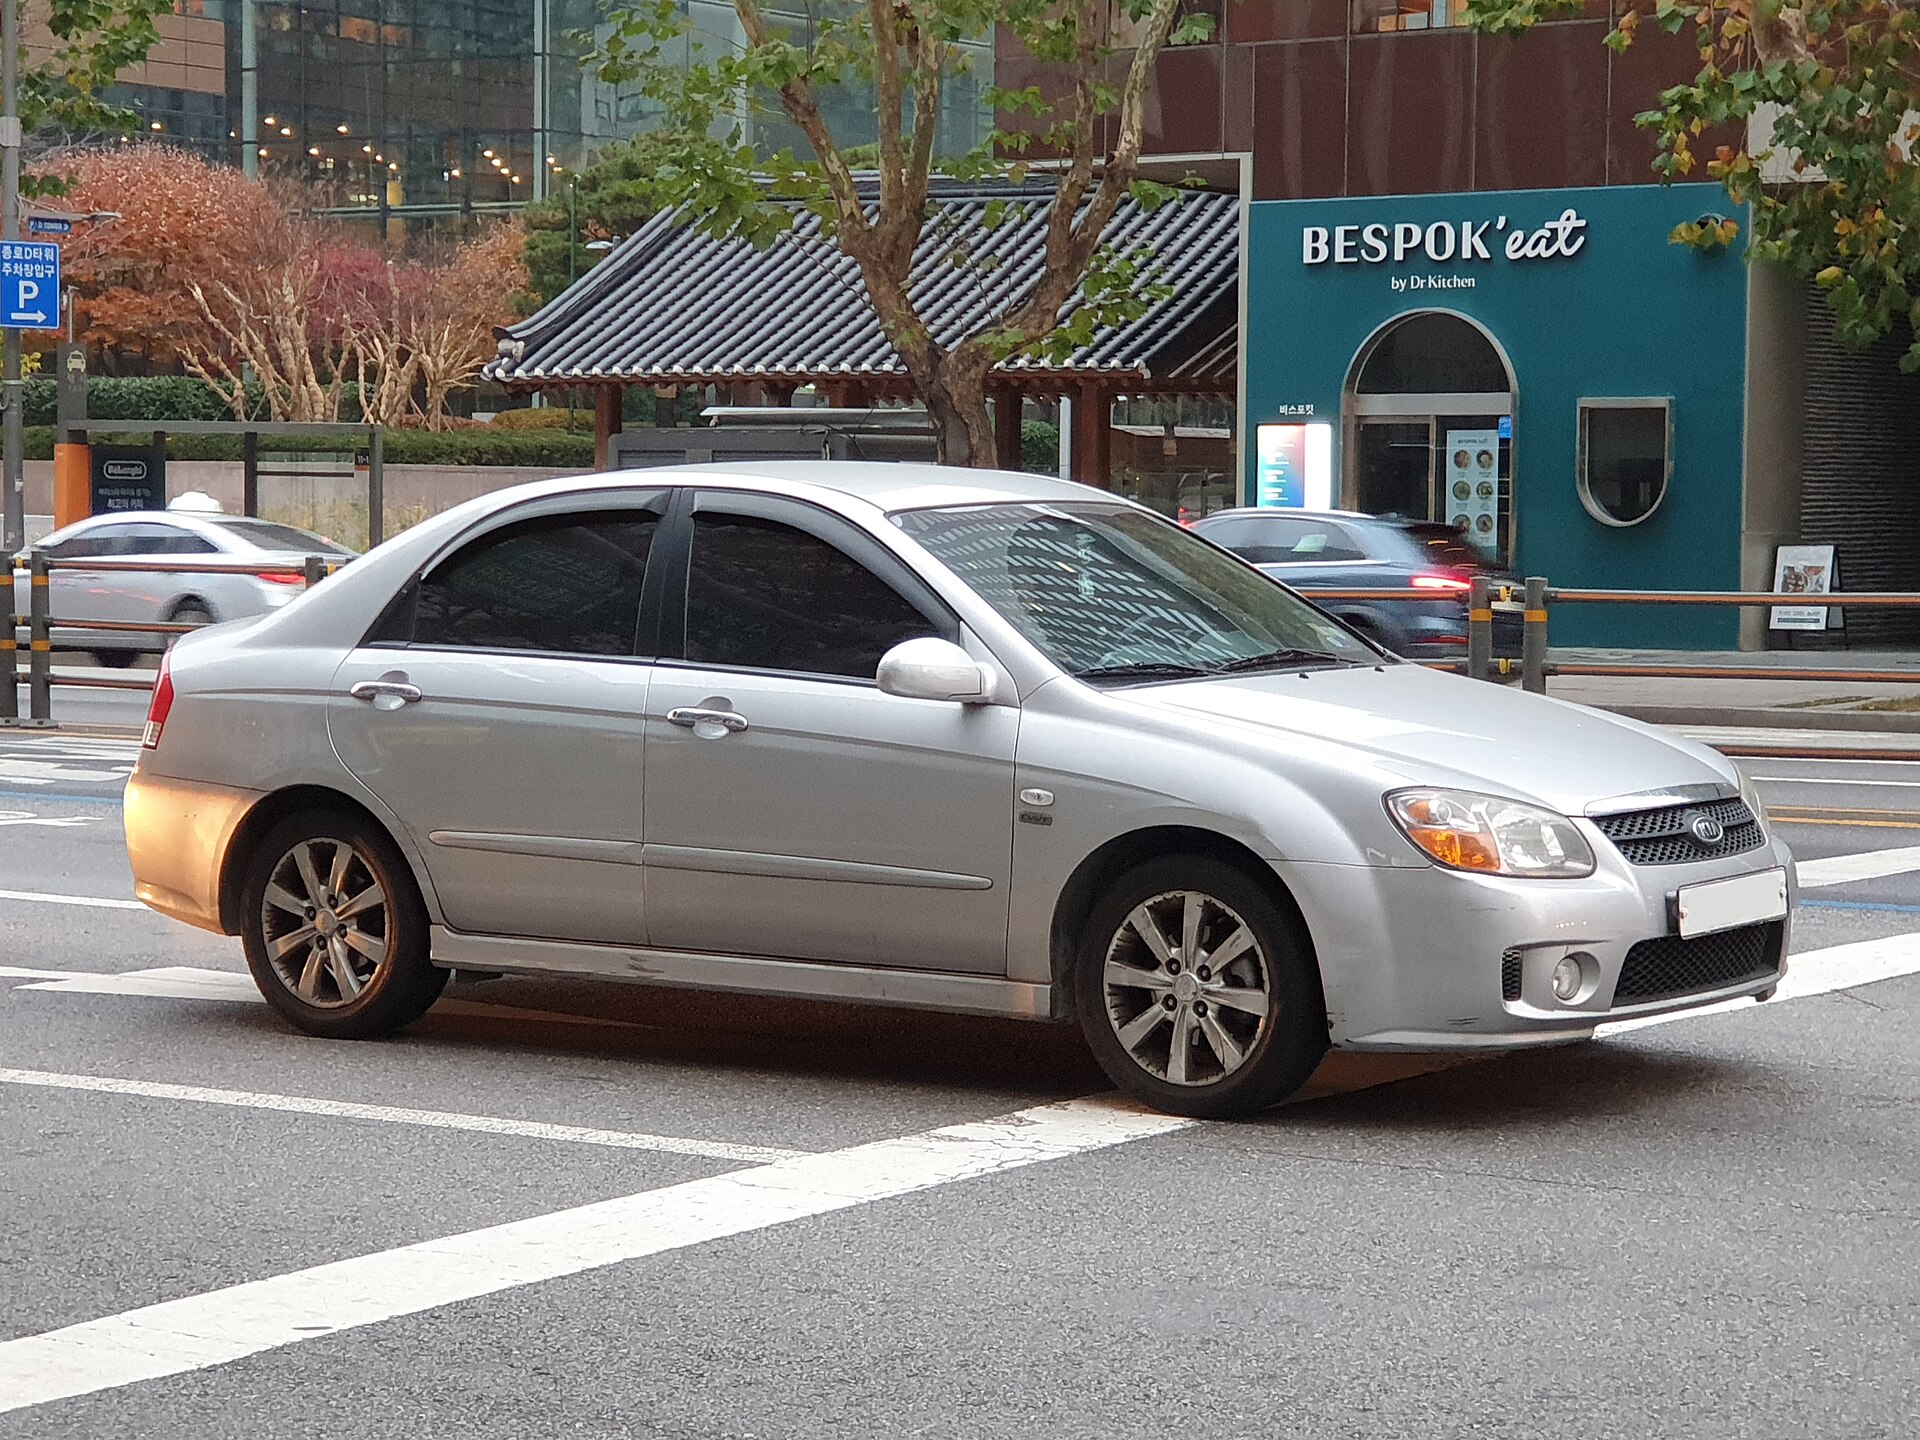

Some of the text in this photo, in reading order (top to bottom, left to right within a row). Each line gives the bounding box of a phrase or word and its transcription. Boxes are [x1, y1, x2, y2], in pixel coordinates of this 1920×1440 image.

[2, 245, 54, 261] 종로D타워
[2, 262, 55, 278] 주차장입구
[1391, 276, 1407, 292] by
[19, 280, 39, 308] P
[1697, 821, 1720, 838] KIA
